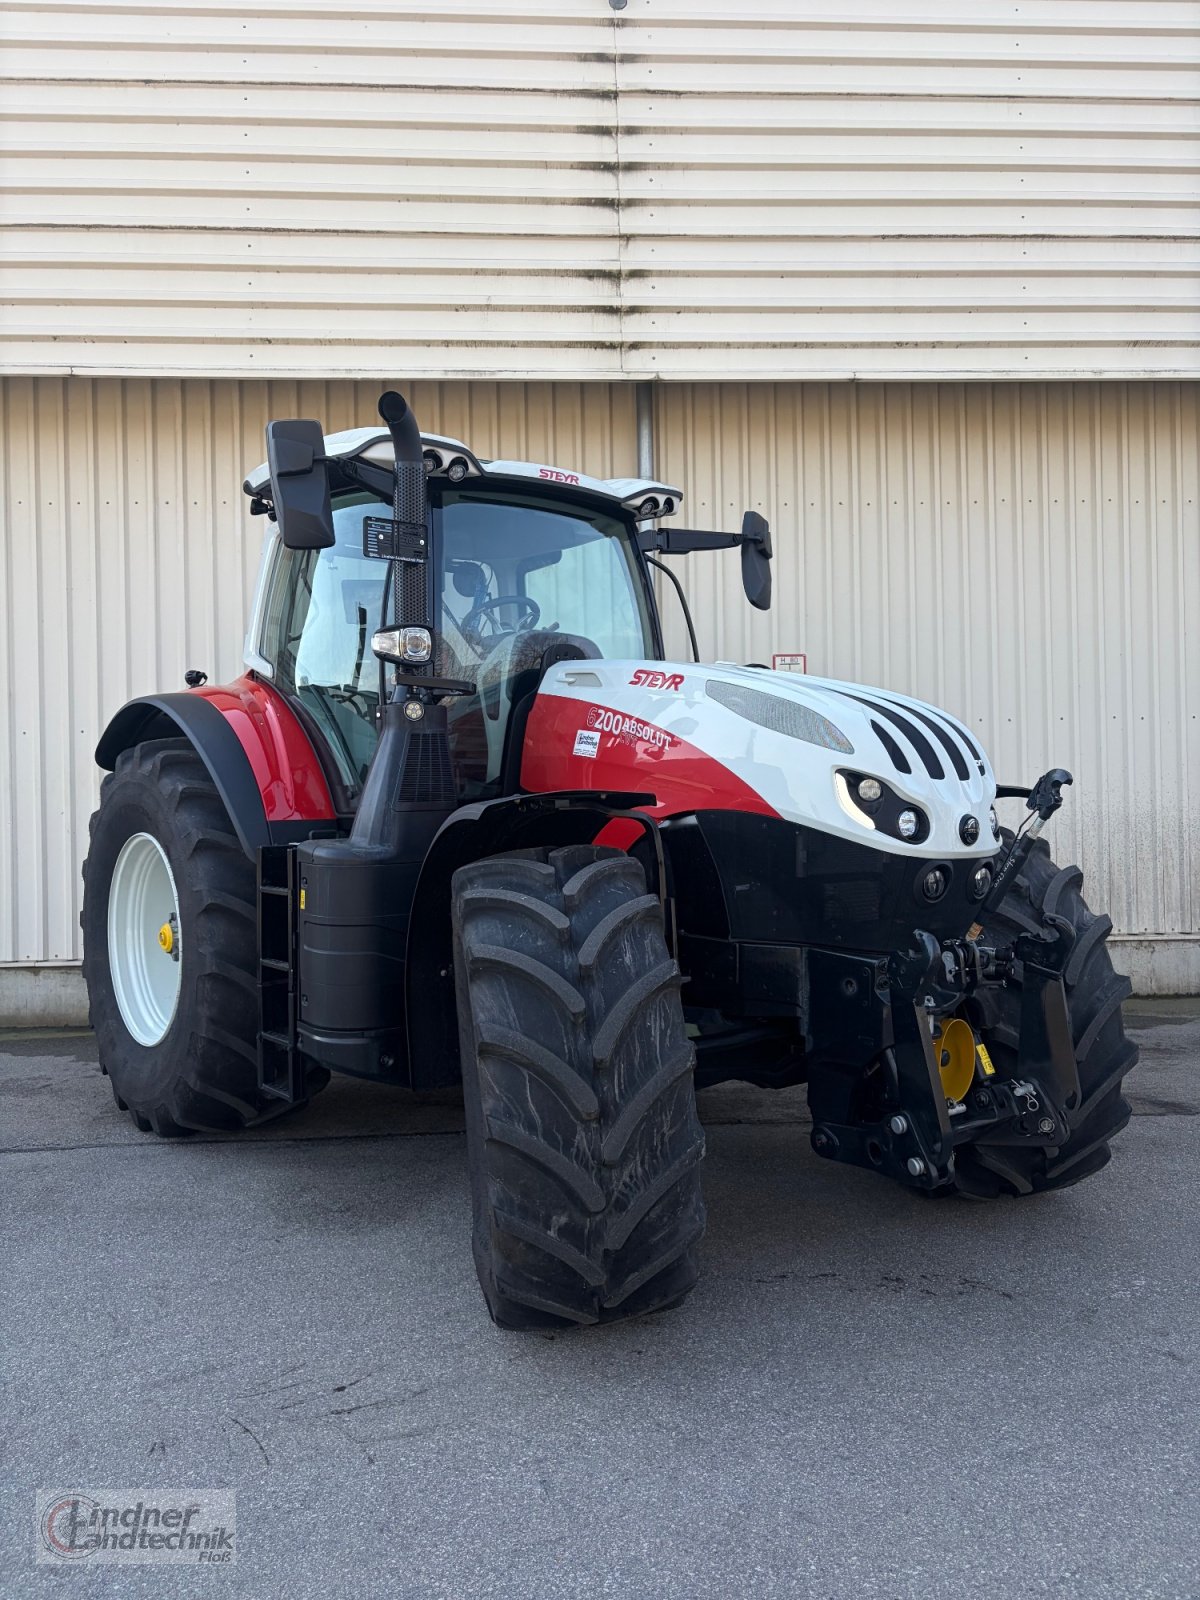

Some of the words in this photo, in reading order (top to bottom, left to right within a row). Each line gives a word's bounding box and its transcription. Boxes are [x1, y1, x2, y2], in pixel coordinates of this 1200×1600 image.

[539, 468, 579, 485] STEYR
[629, 669, 685, 691] STEYR
[587, 706, 622, 735] 6200
[621, 717, 672, 751] ABSOLUT
